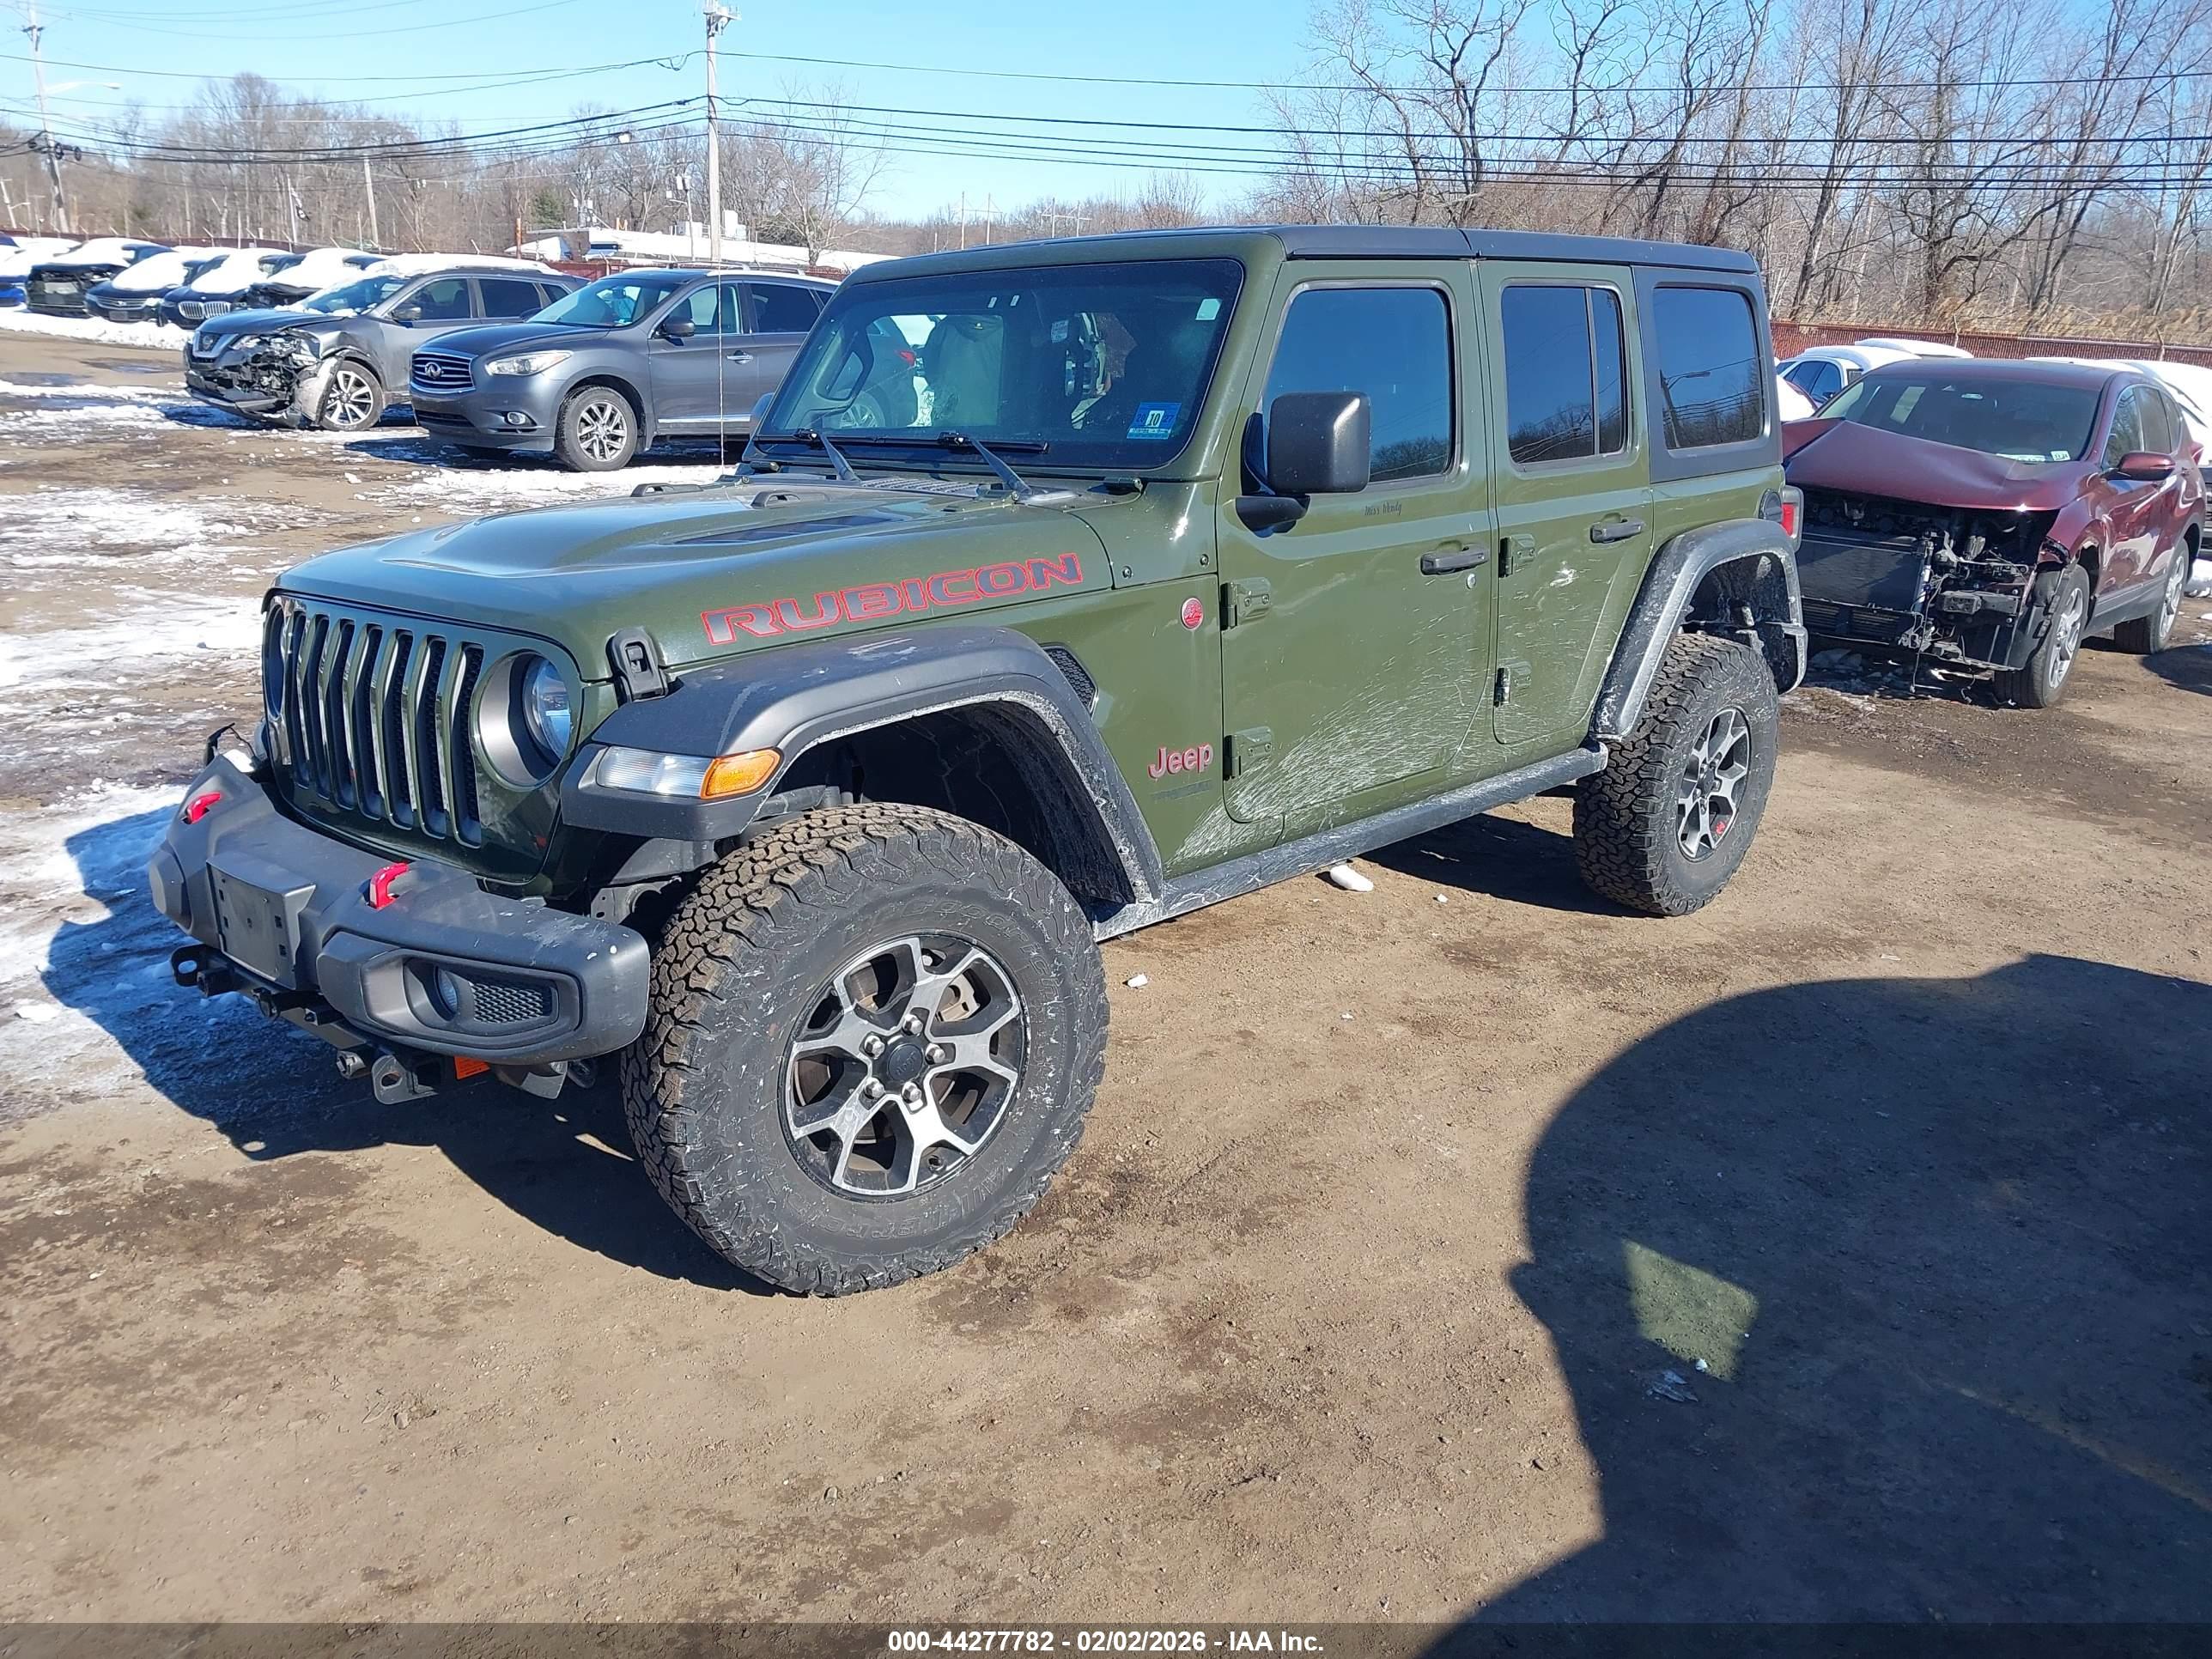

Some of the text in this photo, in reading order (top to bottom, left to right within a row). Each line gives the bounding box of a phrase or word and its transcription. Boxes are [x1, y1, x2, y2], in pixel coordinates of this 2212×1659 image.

[1147, 412, 1161, 426] 10
[702, 553, 1083, 646] RUBICON
[1148, 743, 1213, 779] Jeep
